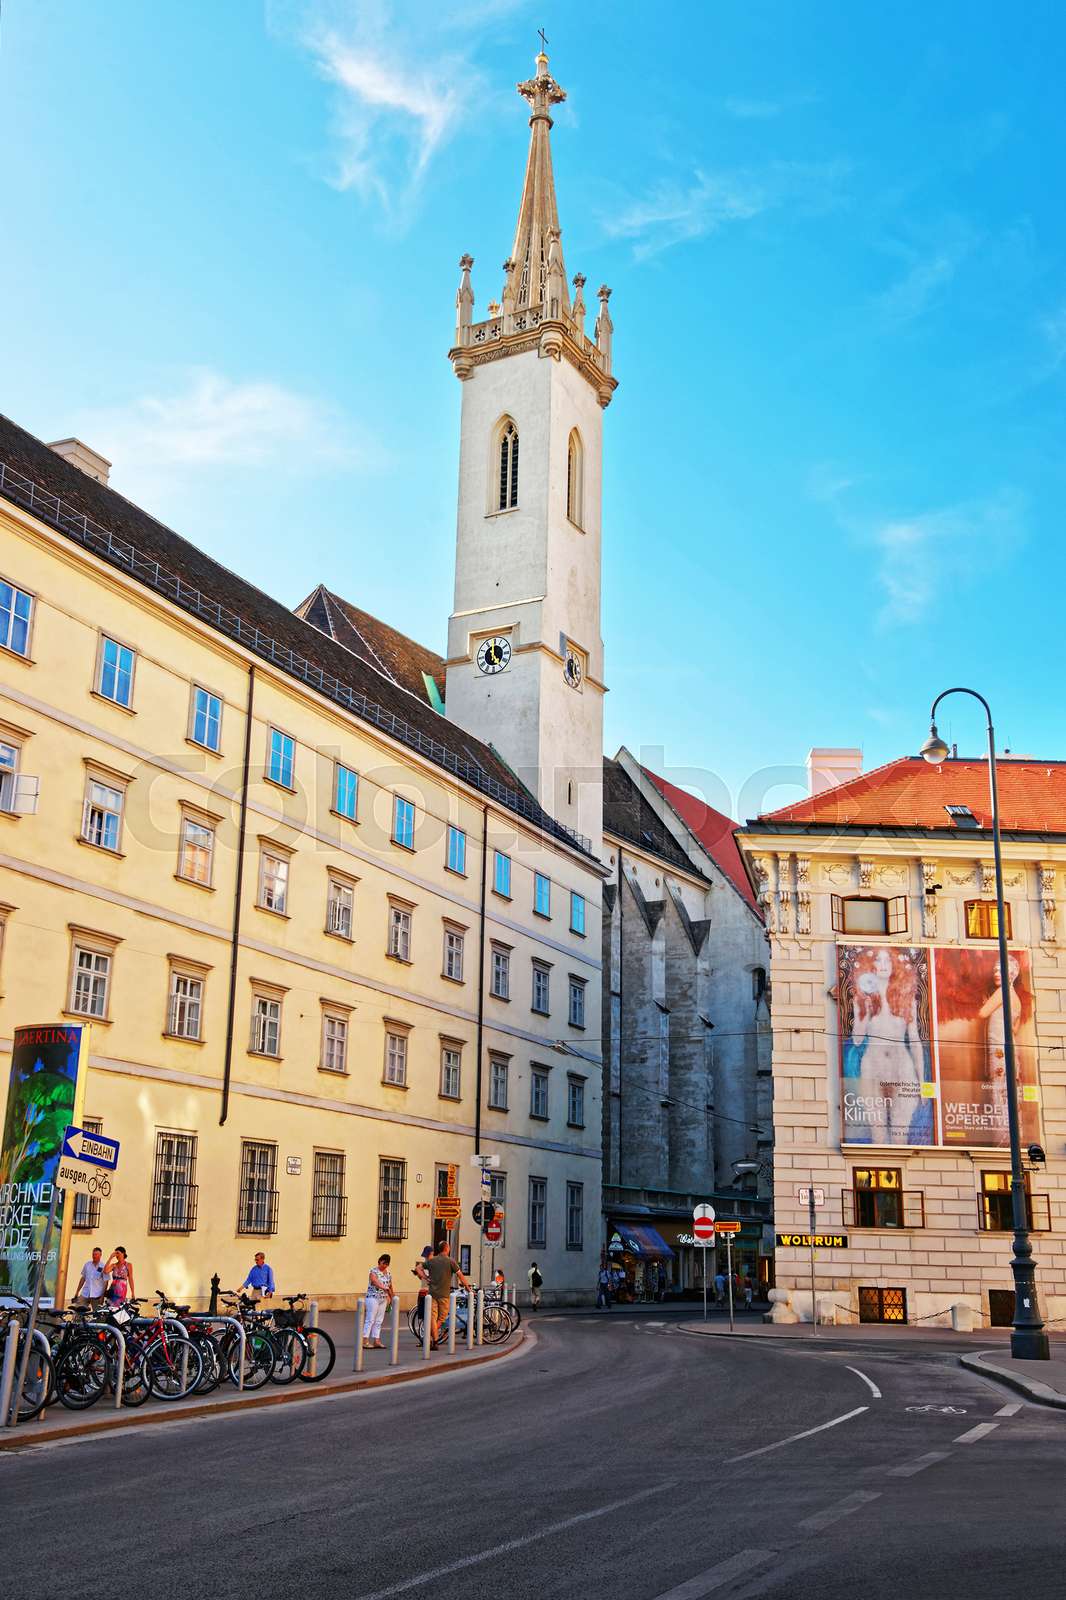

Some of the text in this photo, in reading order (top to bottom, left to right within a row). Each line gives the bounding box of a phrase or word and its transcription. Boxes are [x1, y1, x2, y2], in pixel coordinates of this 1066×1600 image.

[844, 1092, 893, 1111] Gegen
[945, 1103, 980, 1115] WELT
[845, 1106, 883, 1121] Klimt
[81, 1139, 113, 1161] EINBAHN
[60, 1167, 88, 1184] ausgen.
[26, 1251, 57, 1261] WERER
